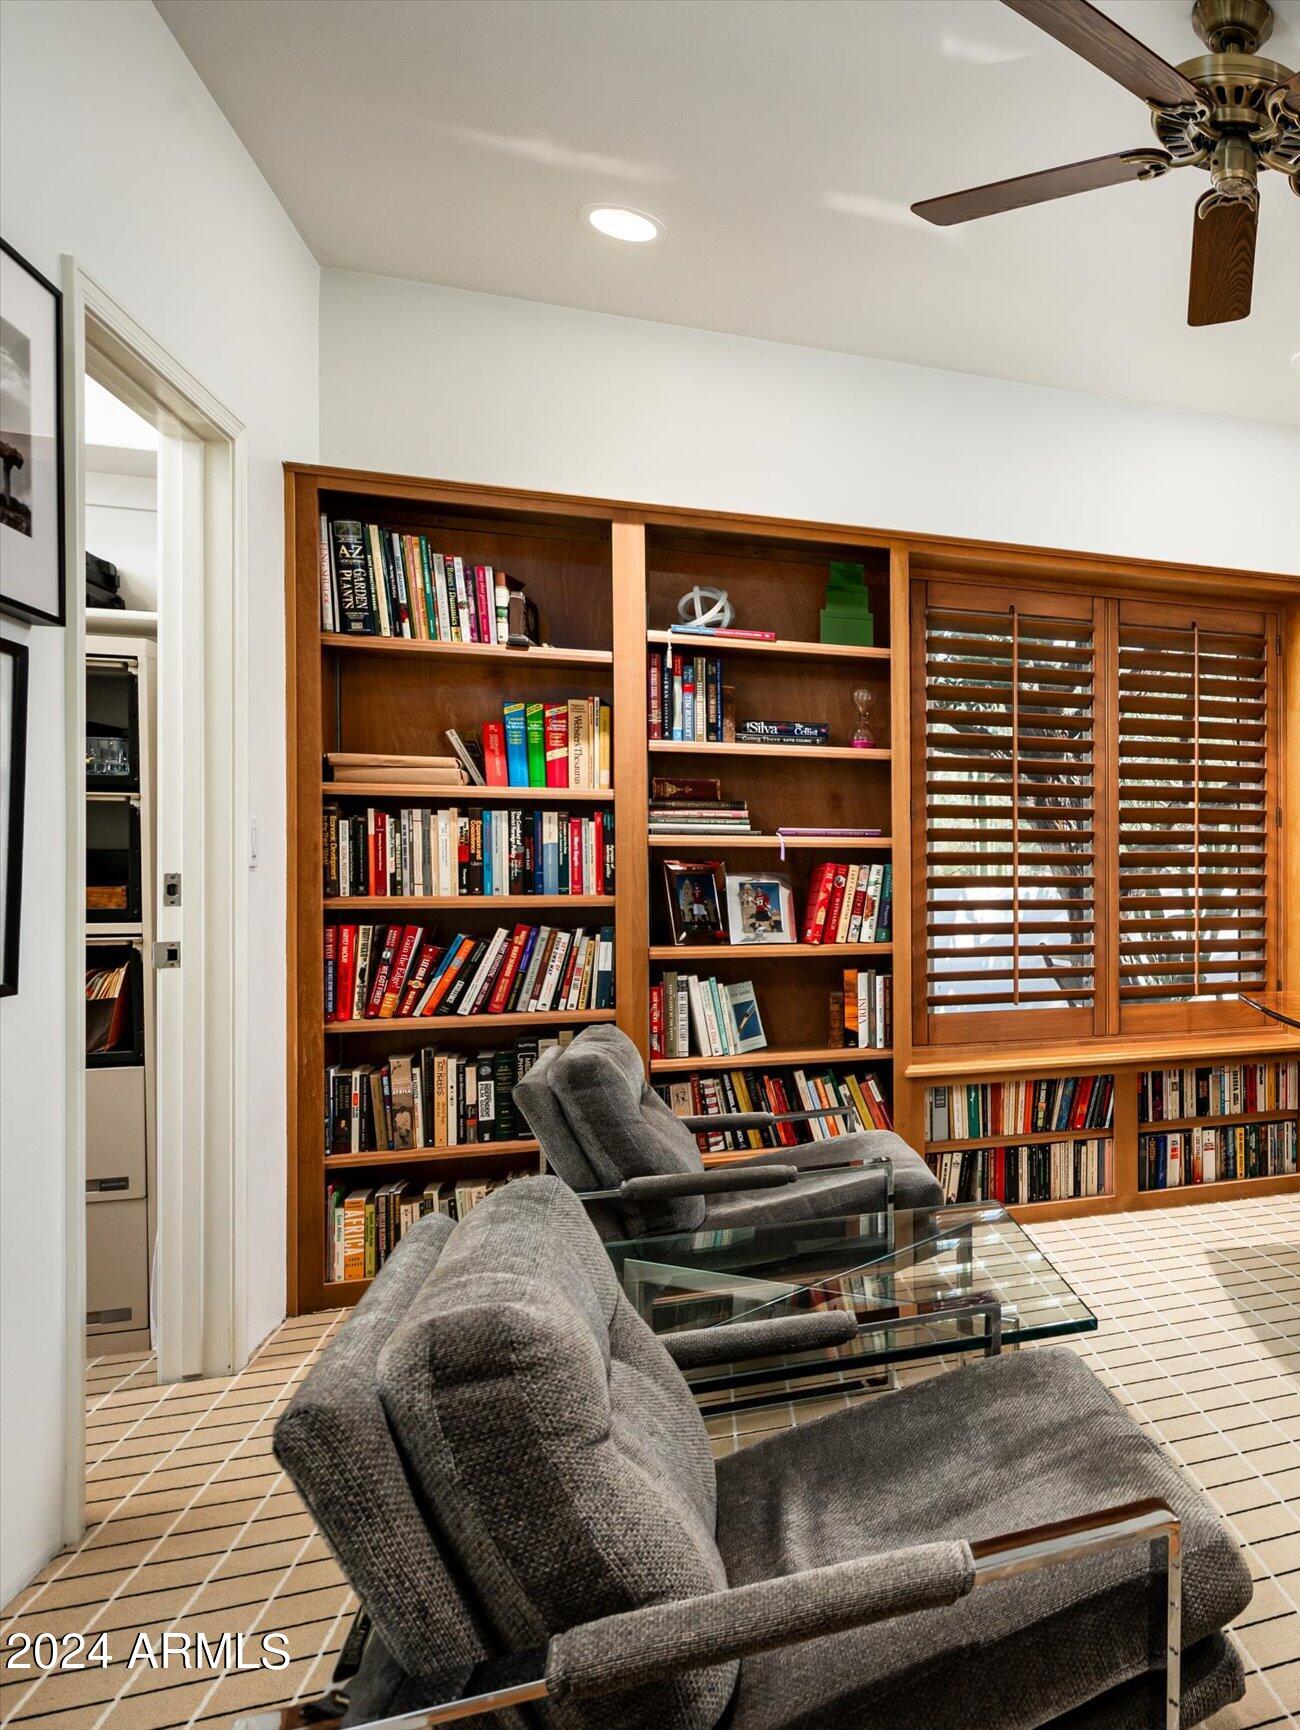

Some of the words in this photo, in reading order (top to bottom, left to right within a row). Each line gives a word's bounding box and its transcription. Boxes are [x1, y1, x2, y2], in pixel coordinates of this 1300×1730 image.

[340, 570, 354, 609] PLANTS
[353, 569, 367, 609] GARDEN
[450, 592, 458, 626] Dummies
[572, 715, 583, 747] Webster's
[750, 722, 778, 734] Silva
[572, 748, 583, 784] Thesaurus
[832, 898, 840, 930] MATRIARCH
[844, 886, 852, 920] CLEMENTINE
[400, 954, 409, 966] the
[402, 936, 414, 952] Gain
[380, 966, 388, 974] WE
[391, 967, 404, 989] Edge!
[416, 967, 427, 981] CHILD
[373, 987, 383, 1005] FIRED!
[345, 1211, 364, 1256] AFRICA
